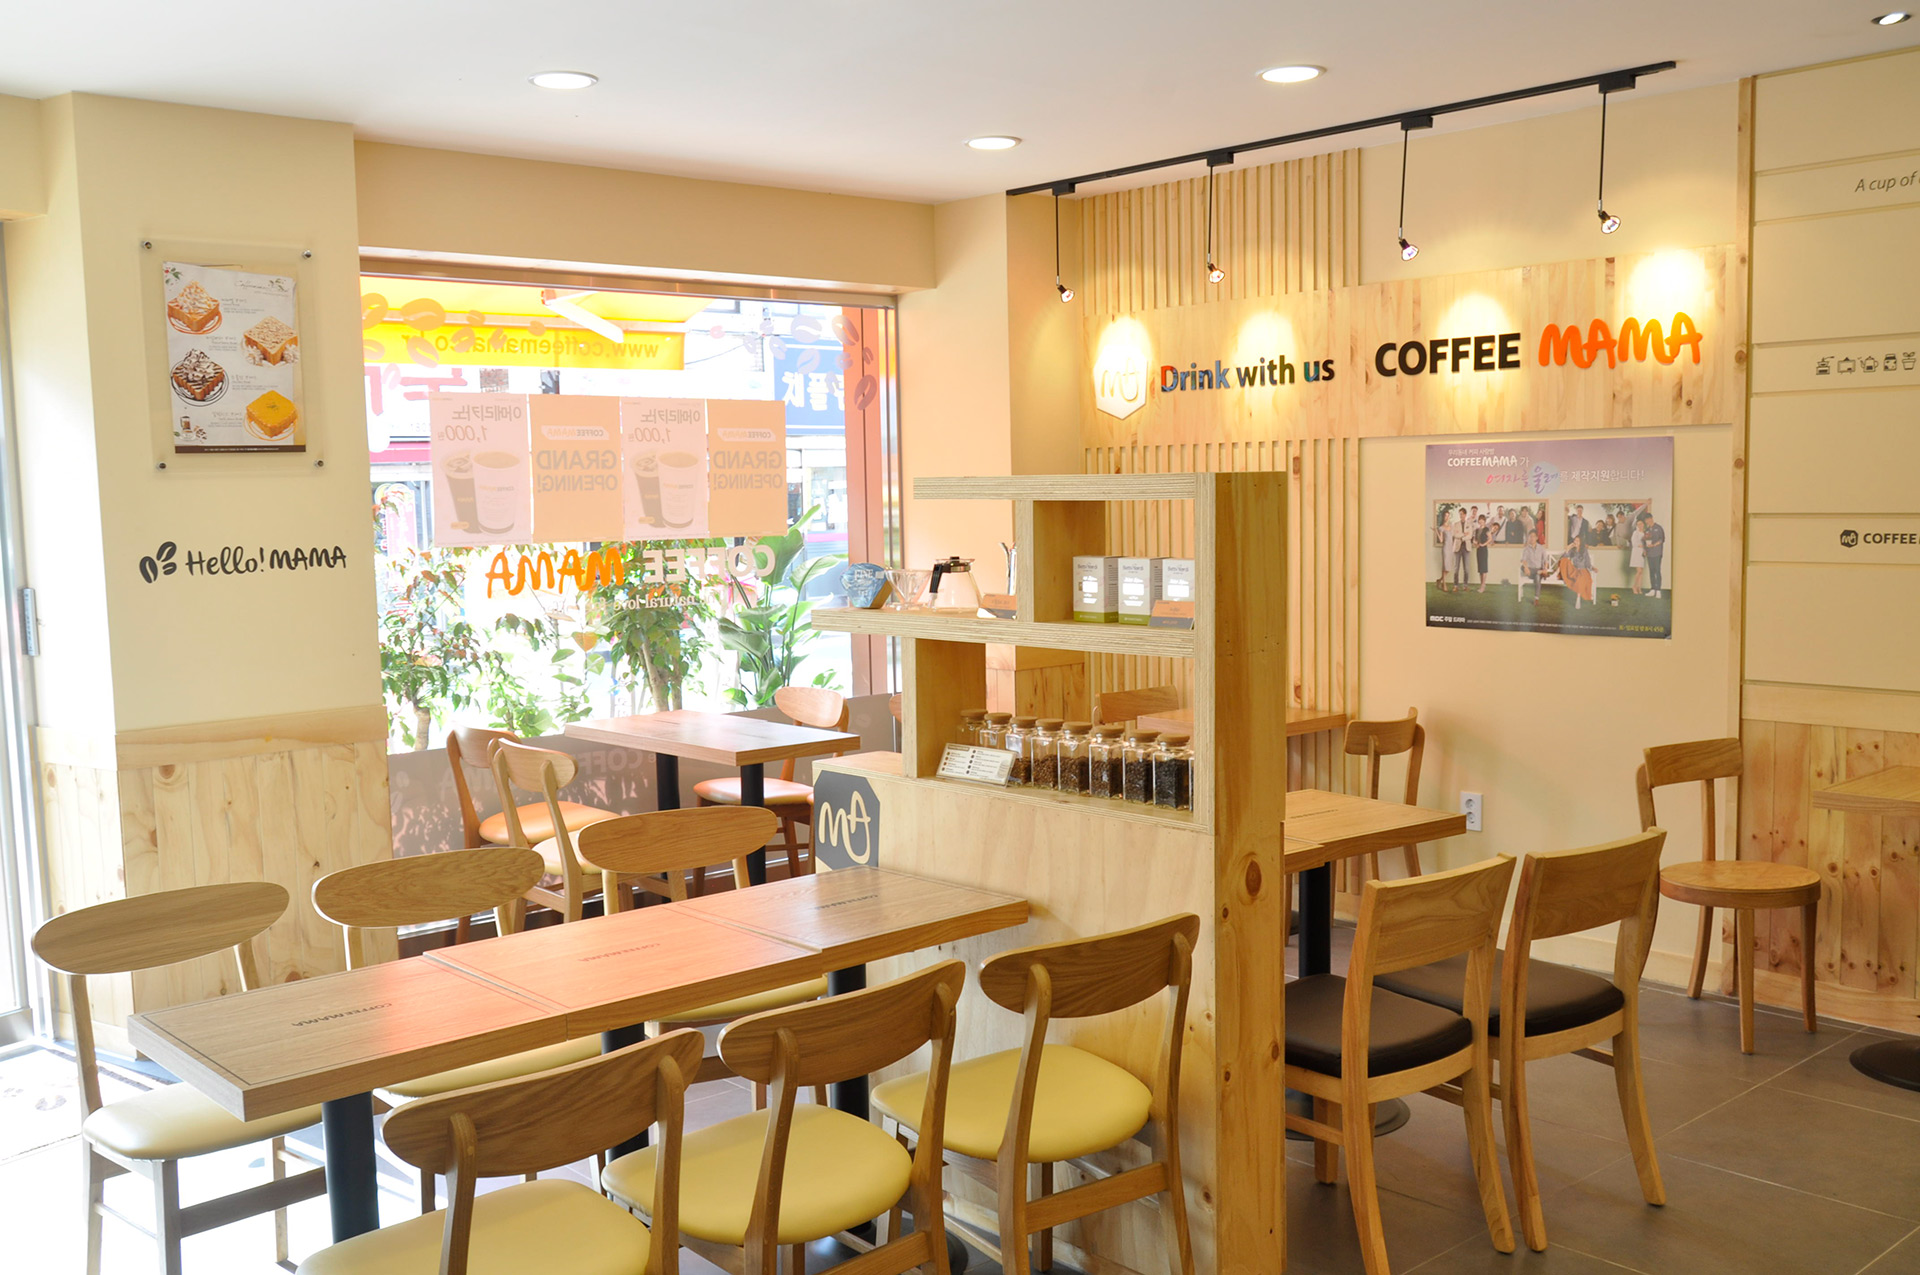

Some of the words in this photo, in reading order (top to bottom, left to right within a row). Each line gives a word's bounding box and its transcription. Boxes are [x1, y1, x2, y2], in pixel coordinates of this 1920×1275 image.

[1854, 178, 1865, 193] A
[1869, 177, 1897, 192] cup
[1900, 170, 1919, 187] of
[1375, 332, 1522, 378] COFFEE
[1537, 311, 1703, 370] MAMA
[1161, 359, 1231, 394] Drink
[1236, 354, 1296, 387] with
[1303, 355, 1336, 382] us
[1863, 532, 1918, 544] COFFEE
[269, 545, 347, 571] MAMA
